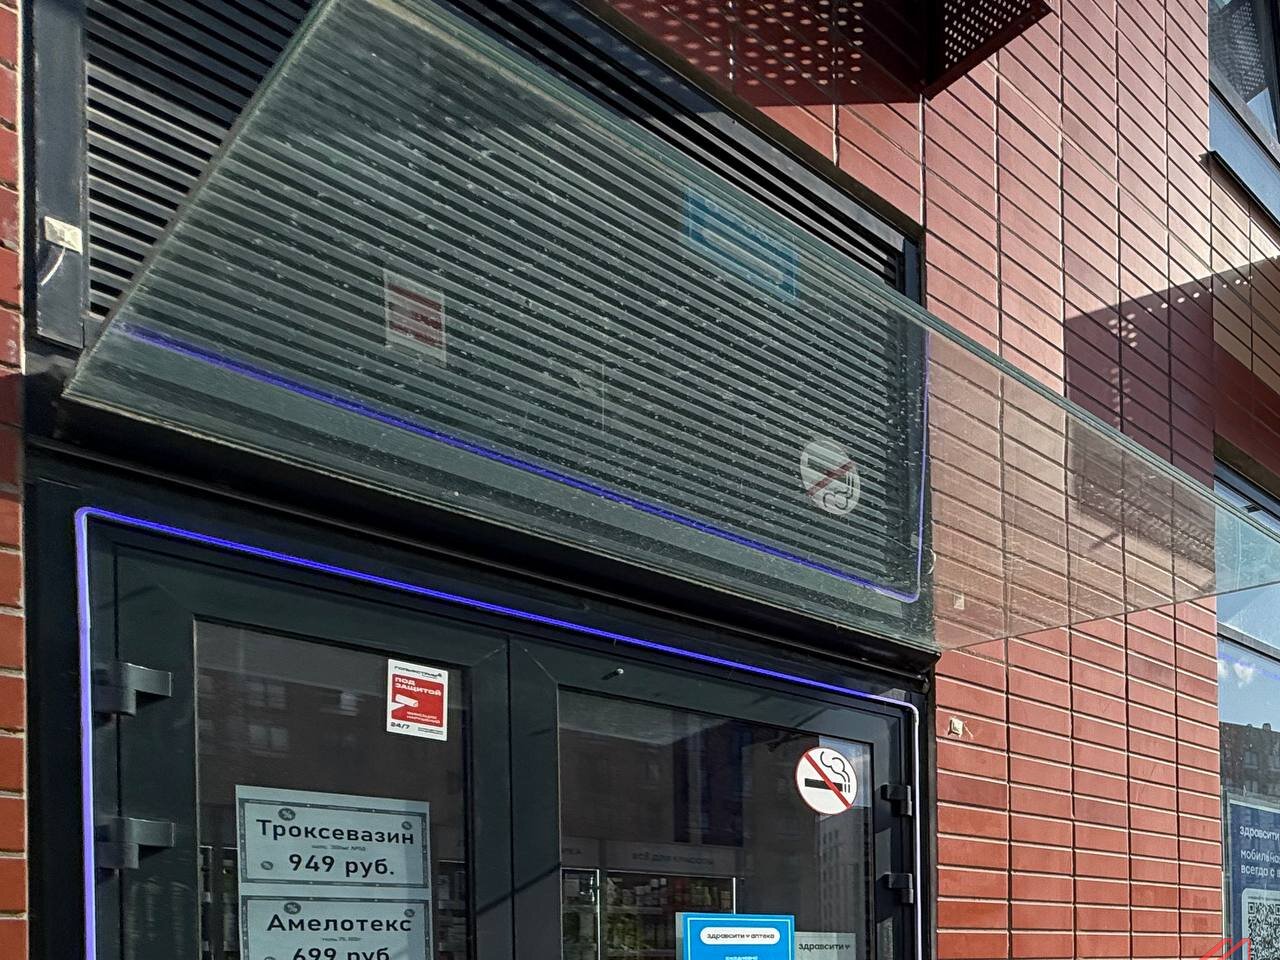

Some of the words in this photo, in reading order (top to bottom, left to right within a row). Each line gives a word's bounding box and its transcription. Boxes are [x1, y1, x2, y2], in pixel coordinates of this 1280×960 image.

[395, 677, 415, 686] ПОД
[395, 683, 442, 697] ЗАЩИТОЙ
[390, 721, 410, 730] 24/7
[256, 818, 415, 846] Троксевазин
[1239, 825, 1280, 841] здравсити
[288, 853, 336, 873] 949
[345, 858, 395, 878] руб.
[1240, 864, 1269, 877] всегда
[266, 914, 412, 932] Амелотекс
[798, 943, 845, 952] здравсити
